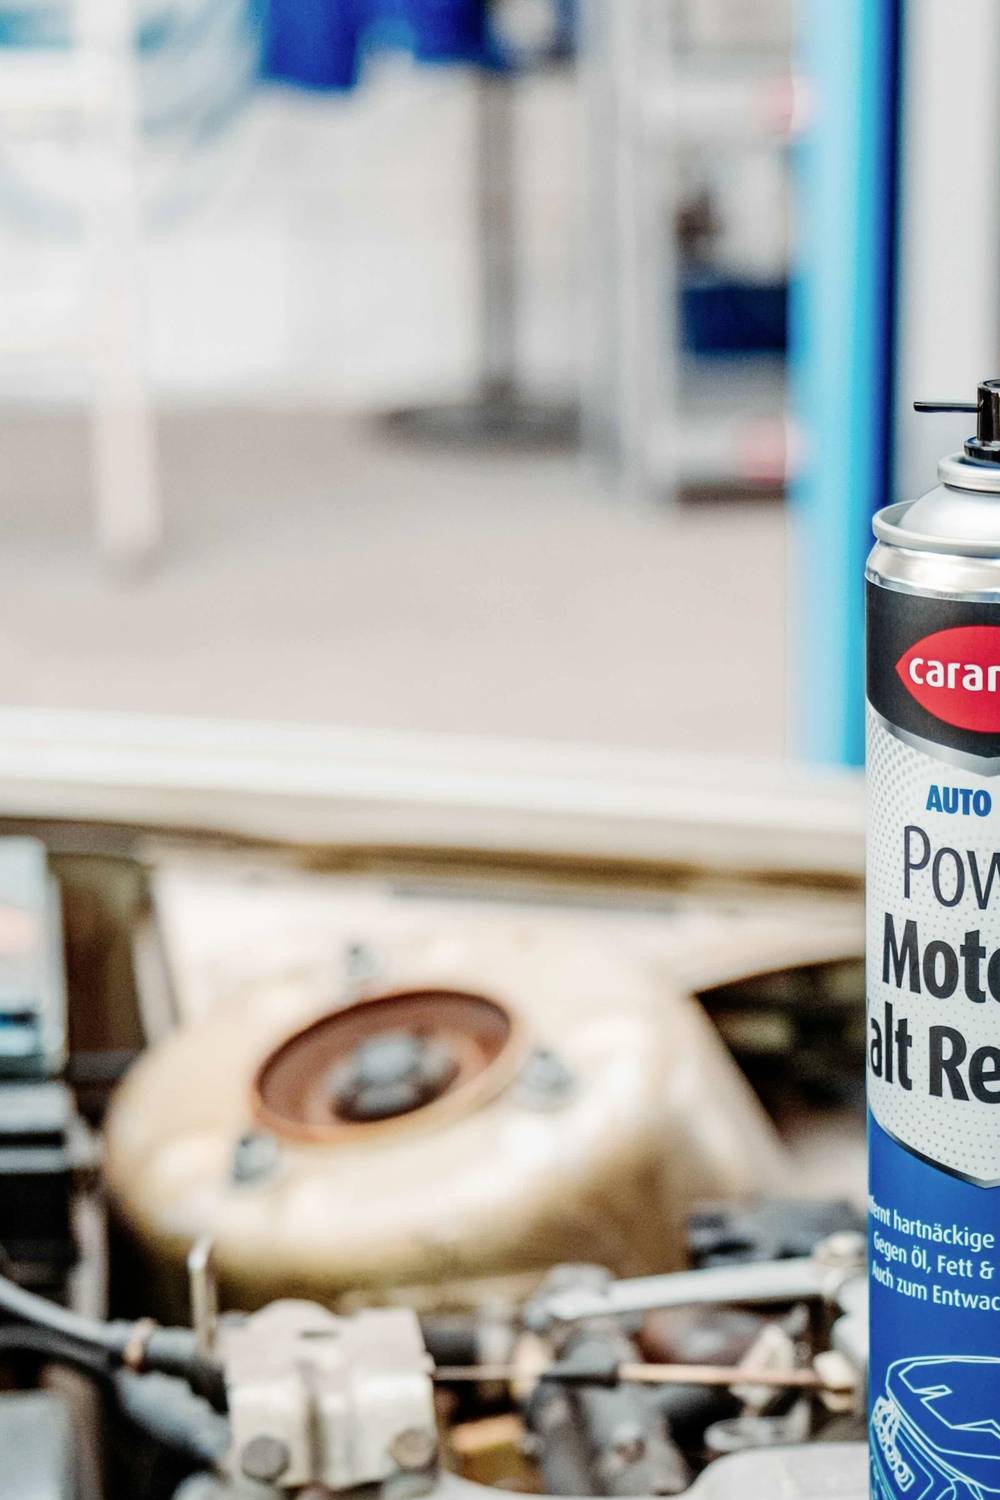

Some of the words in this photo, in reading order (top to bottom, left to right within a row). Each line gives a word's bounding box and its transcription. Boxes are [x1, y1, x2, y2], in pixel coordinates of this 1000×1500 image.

[925, 784, 992, 817] AUTO
[867, 998, 914, 1091] alt
[893, 1208, 995, 1252] hartnäckige
[873, 1230, 907, 1265] Gegen
[911, 1244, 932, 1274] Öl,
[937, 1254, 973, 1279] Fett
[979, 1260, 995, 1280] &
[871, 1259, 894, 1289] Auch
[896, 1277, 928, 1301] zum
